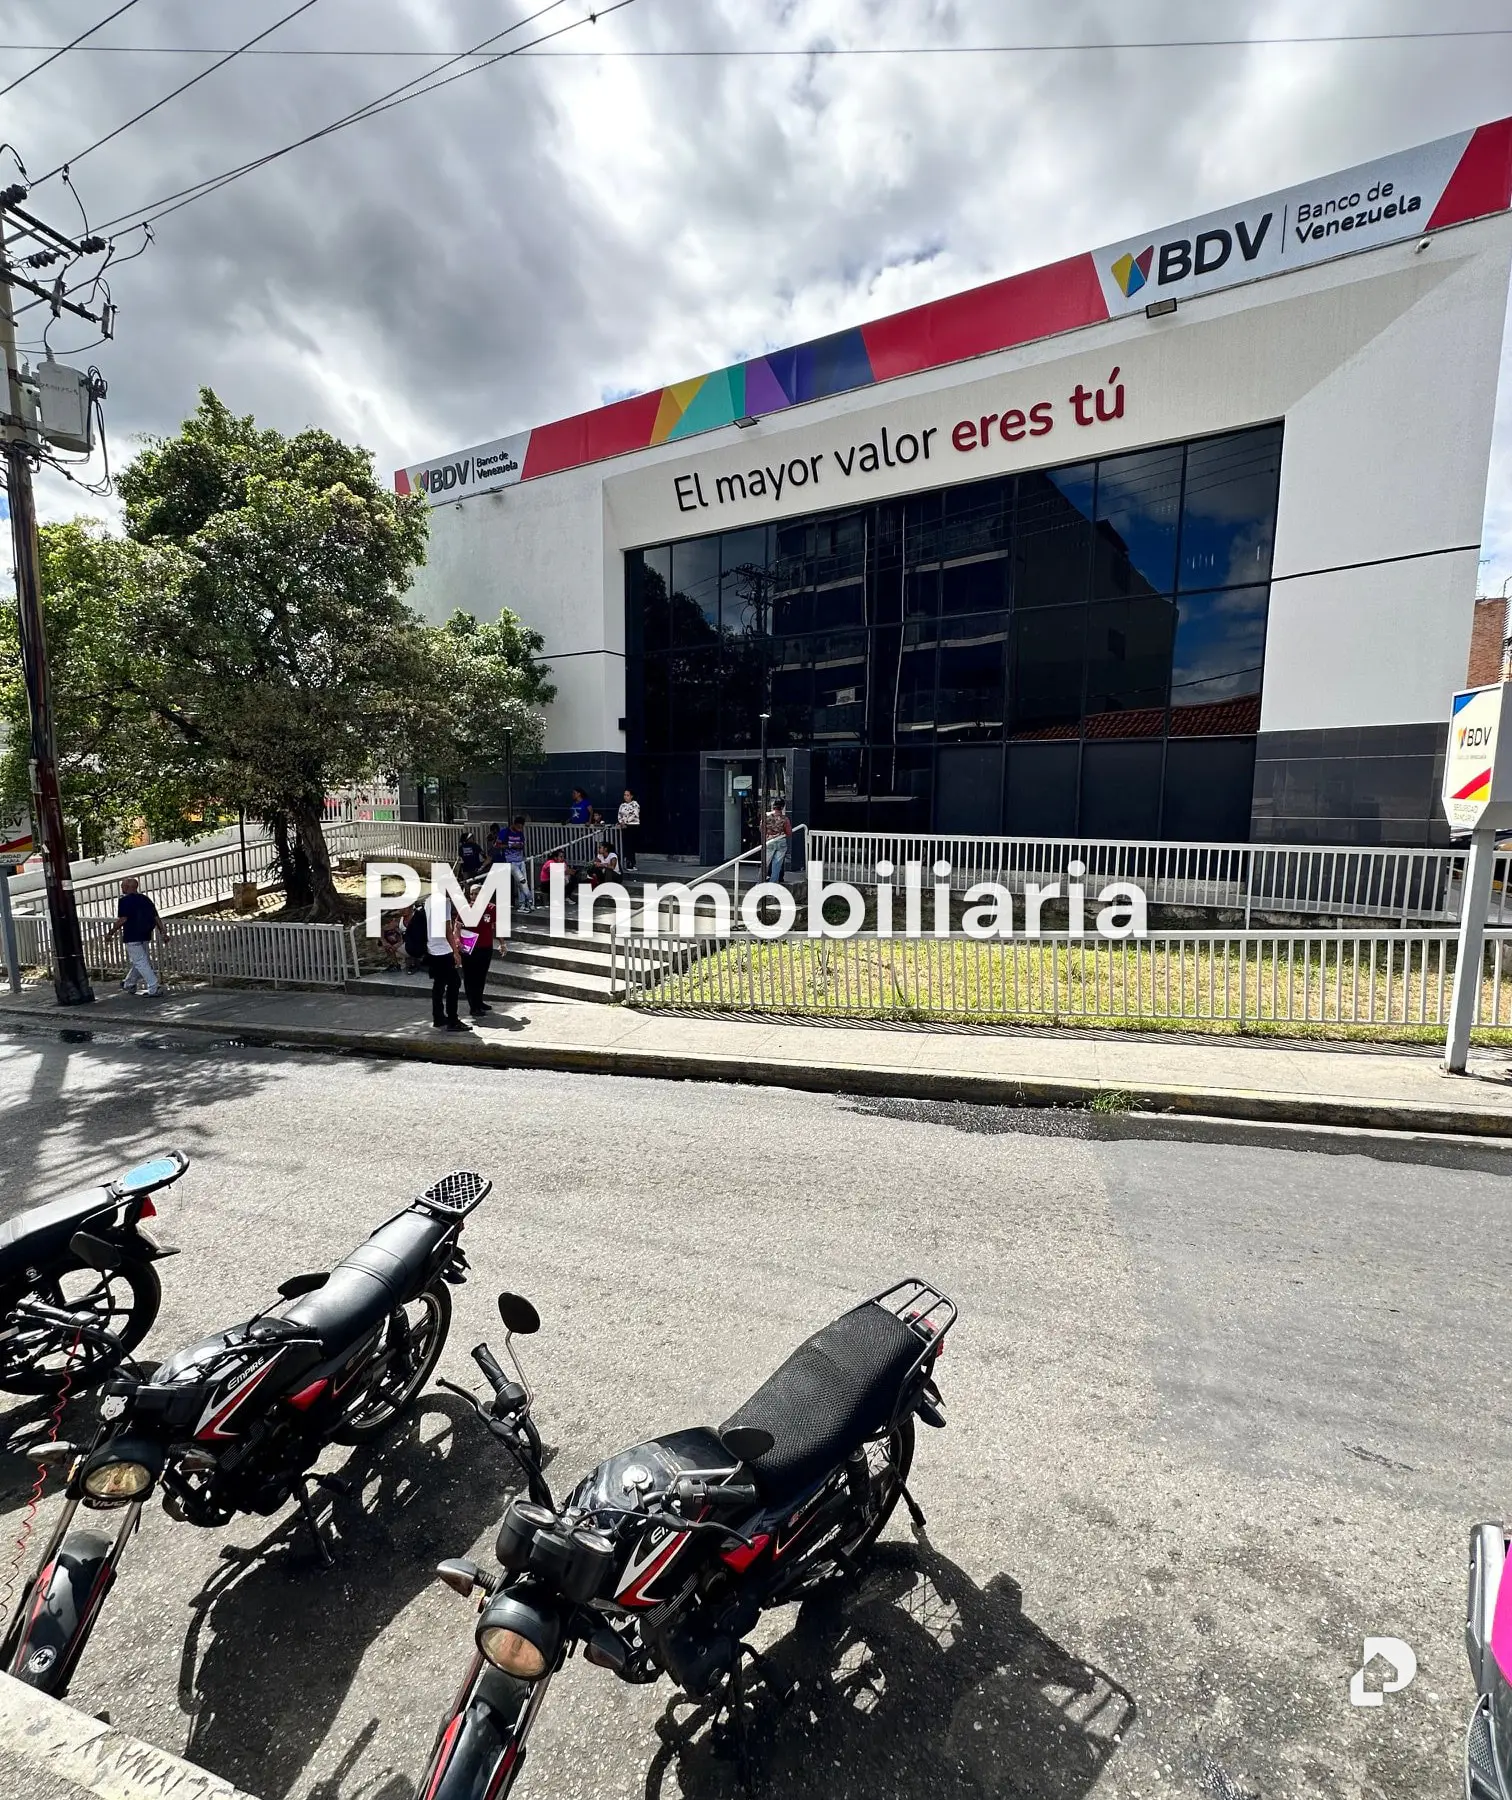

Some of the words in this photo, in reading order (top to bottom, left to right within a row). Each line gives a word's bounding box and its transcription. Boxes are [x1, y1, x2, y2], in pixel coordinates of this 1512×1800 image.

[1296, 195, 1422, 244] Venezuela
[1297, 193, 1360, 224] Banco
[1367, 181, 1394, 202] de
[1158, 212, 1273, 286] BDV
[674, 471, 709, 512] El
[715, 454, 823, 501] mayor
[833, 426, 938, 477] valor
[951, 402, 1053, 452] eres
[1069, 366, 1126, 427] tú
[430, 459, 470, 494] BDV
[476, 455, 498, 468] Banco
[498, 451, 509, 461] de
[476, 460, 518, 480] Venezuela
[1466, 726, 1493, 747] BDV
